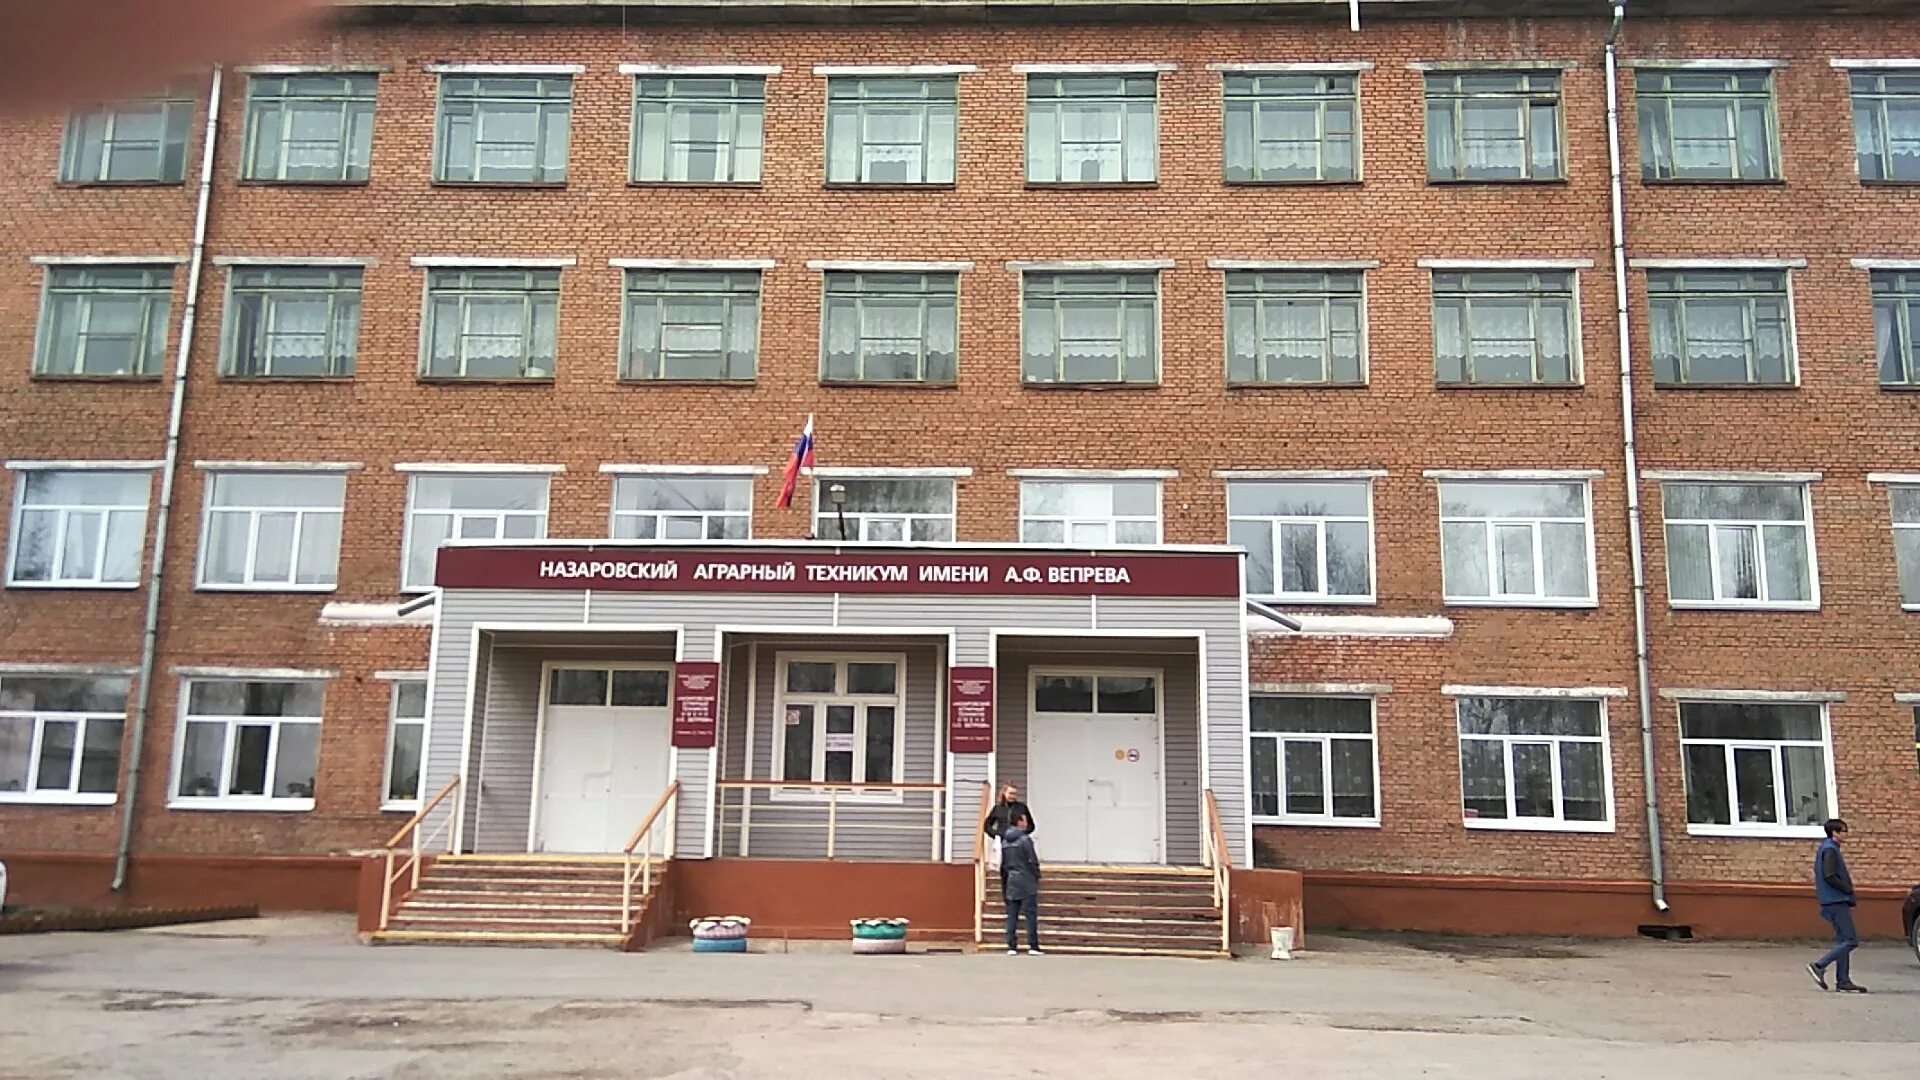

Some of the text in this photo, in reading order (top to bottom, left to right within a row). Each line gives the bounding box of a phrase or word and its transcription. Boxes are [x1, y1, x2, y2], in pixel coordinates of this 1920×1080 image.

[539, 560, 1131, 583] НАЗАРОВСКИЙ АГРАРНЫЙ ТЕХНИКУМ ИМЕНИ А.Ф. ВЕПРЕВА
